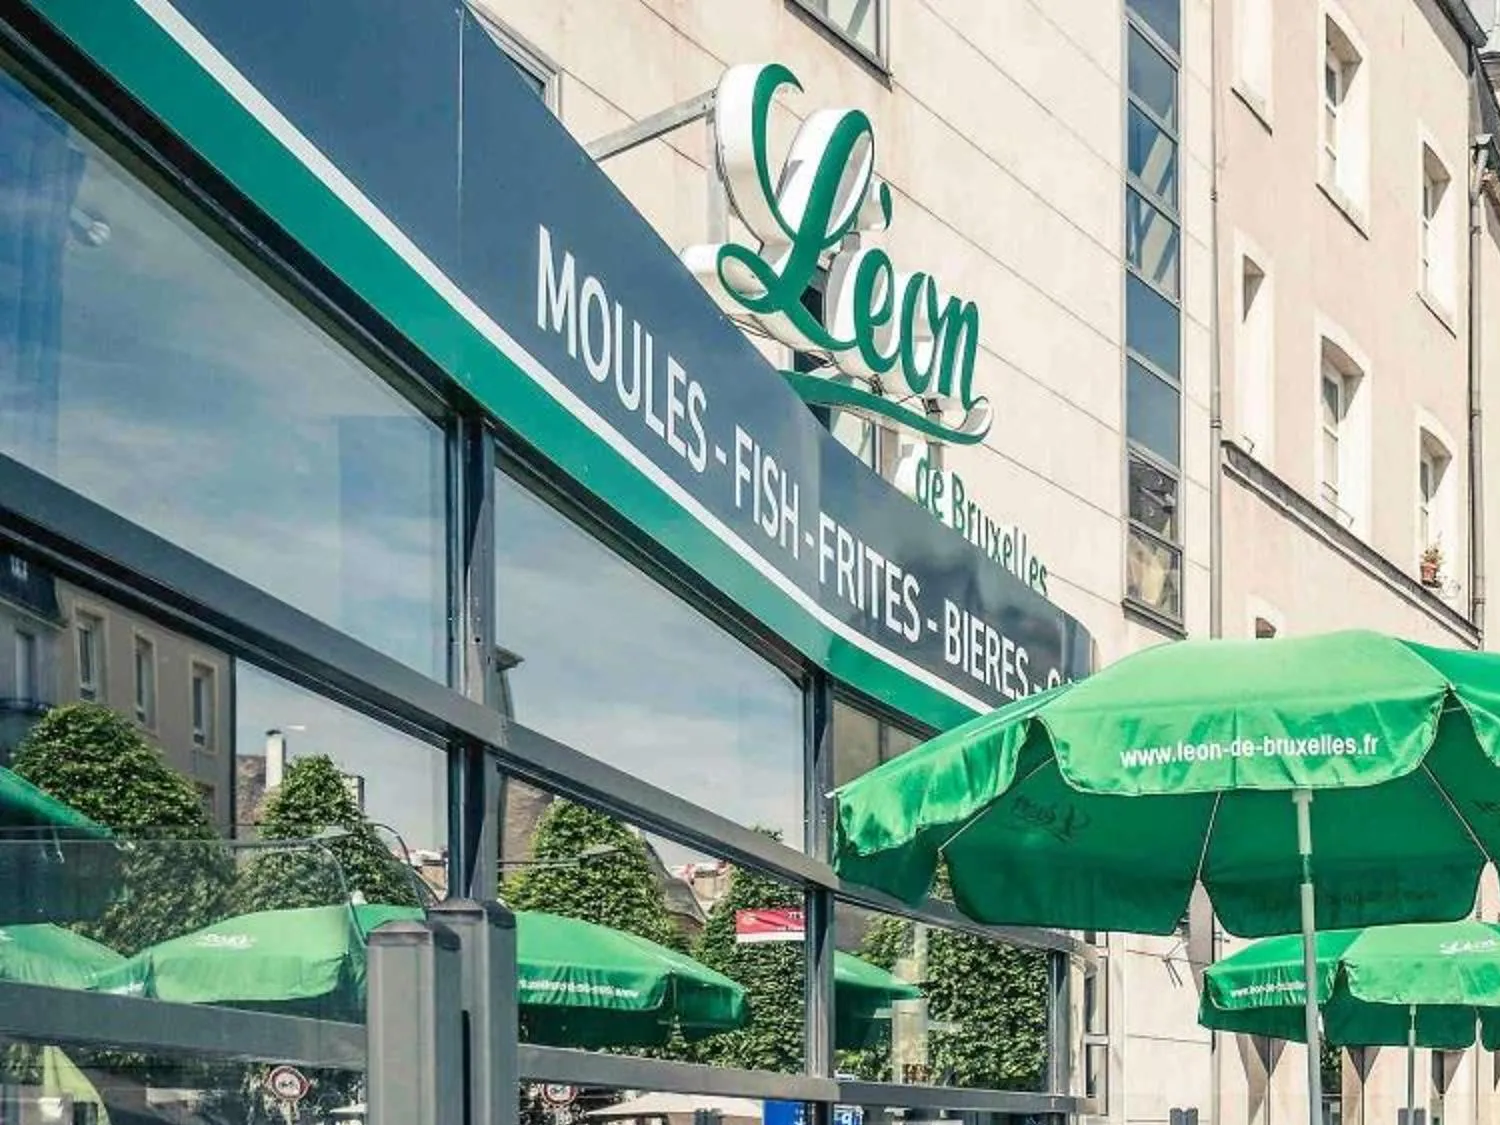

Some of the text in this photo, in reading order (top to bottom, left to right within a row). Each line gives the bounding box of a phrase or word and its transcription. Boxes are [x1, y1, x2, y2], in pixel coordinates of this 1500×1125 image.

[537, 224, 707, 474] MOULES
[735, 425, 799, 560] FISH
[819, 512, 920, 644] FRITES
[944, 600, 1029, 700] BIERES
[915, 455, 1048, 597] de Bruxelles
[1119, 733, 1379, 769] www.leon-de-bruxelles.fr
